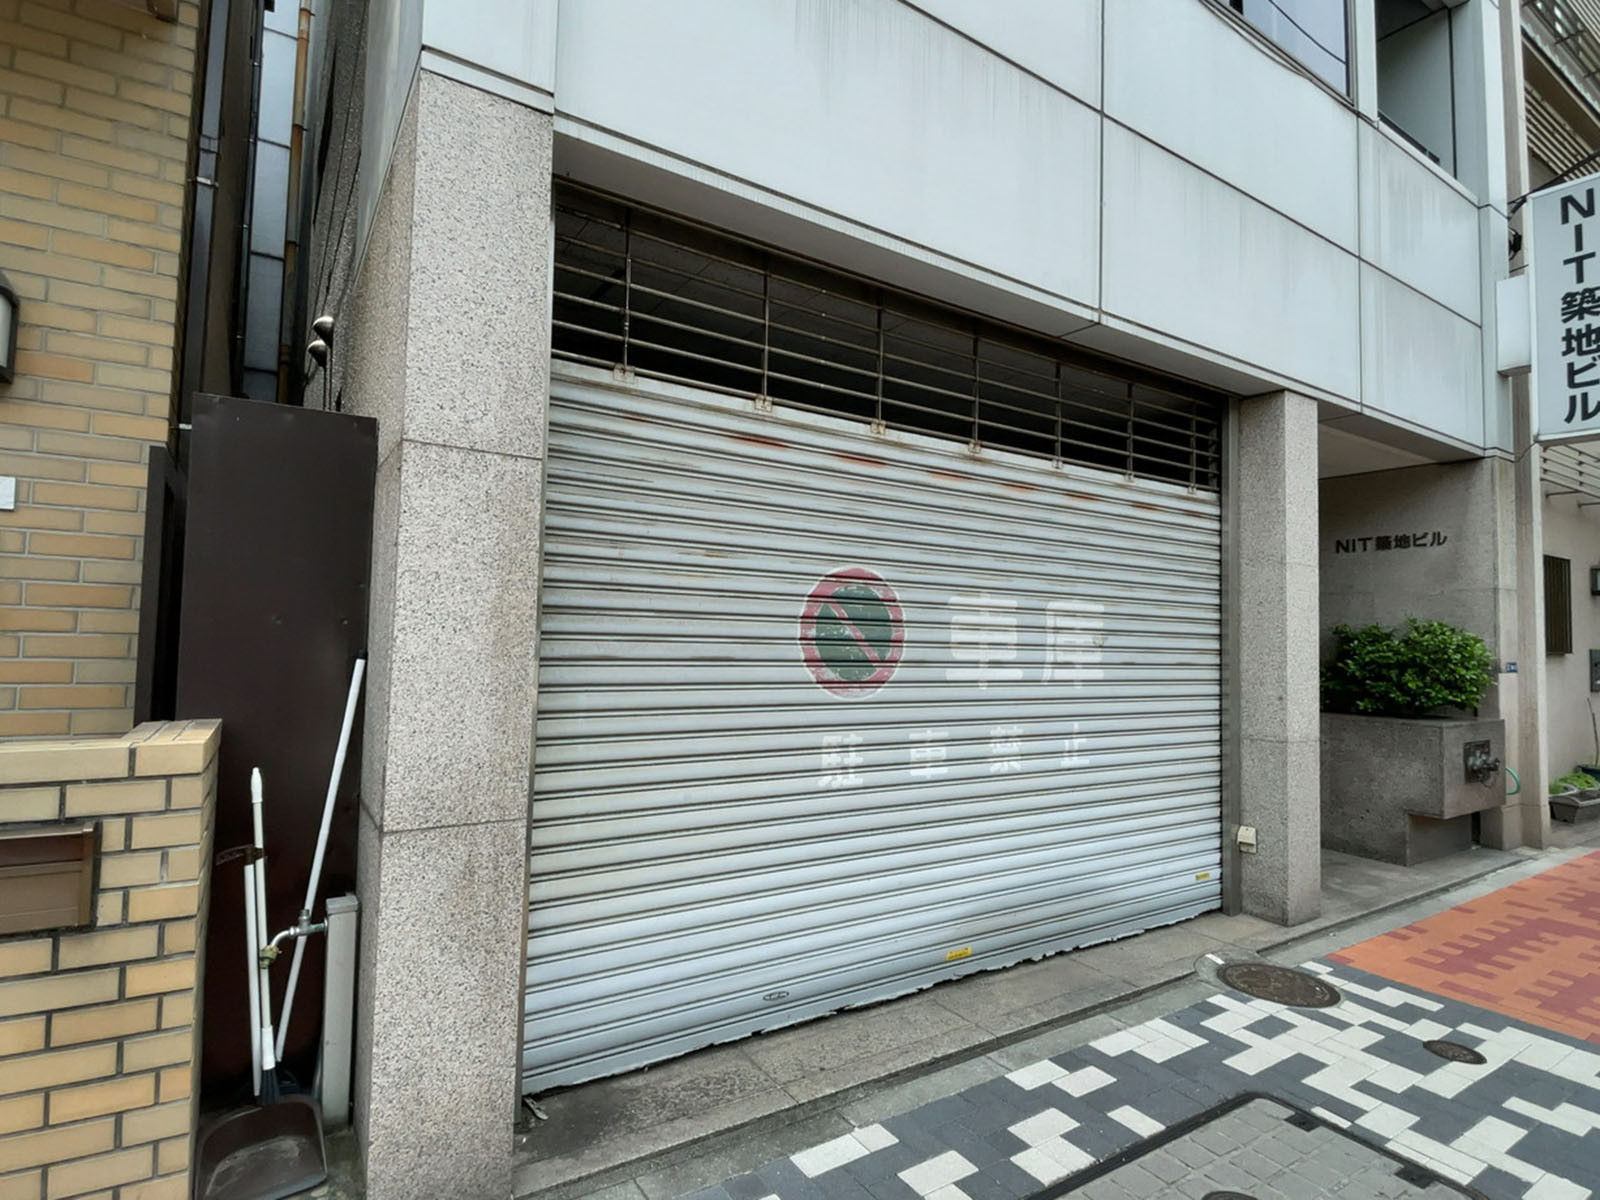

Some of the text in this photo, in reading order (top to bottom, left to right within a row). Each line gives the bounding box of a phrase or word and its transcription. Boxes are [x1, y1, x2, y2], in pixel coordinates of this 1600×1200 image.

[1560, 187, 1600, 424] NIT築地ビル
[945, 592, 1105, 689] 車庫
[818, 722, 1091, 787] 駐車禁止
